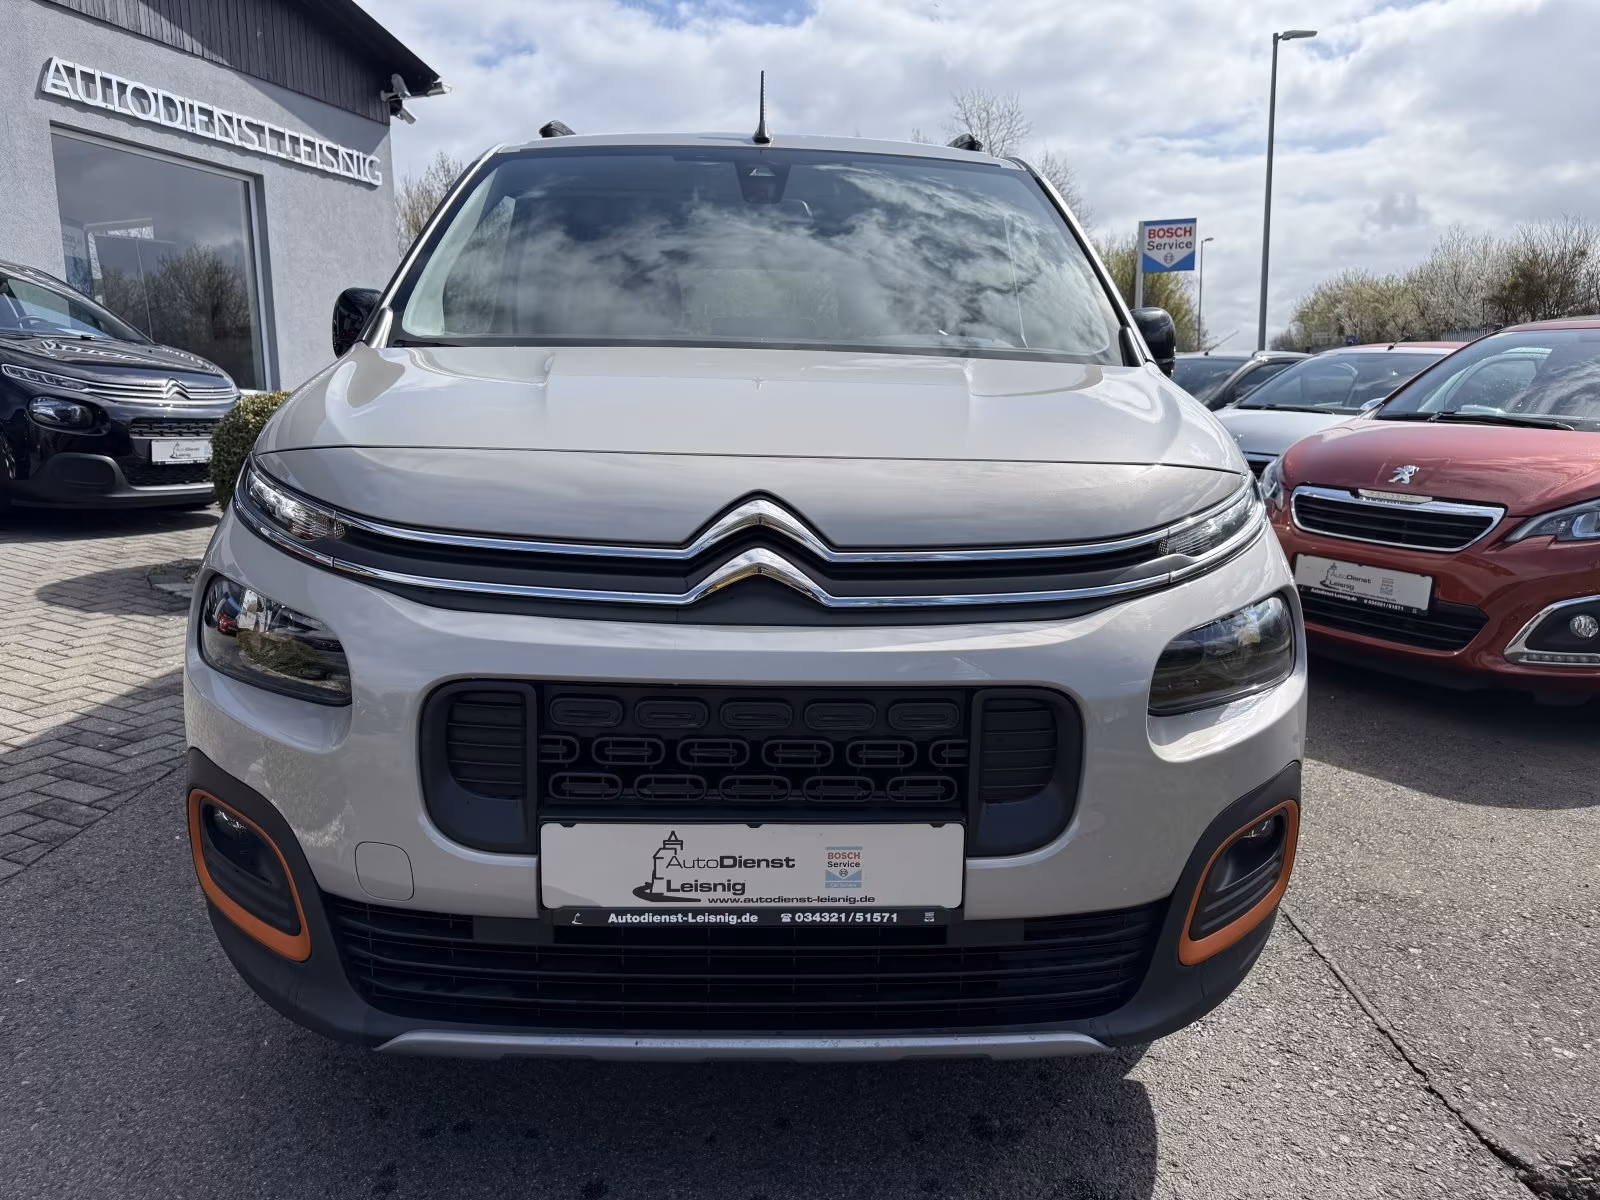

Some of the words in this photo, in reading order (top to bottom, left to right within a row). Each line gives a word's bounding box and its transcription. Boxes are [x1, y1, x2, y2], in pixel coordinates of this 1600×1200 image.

[1148, 226, 1192, 239] BOSCH
[1147, 239, 1193, 251] Service
[1329, 580, 1355, 591] Leisnig
[827, 851, 861, 860] BOSCH
[665, 855, 796, 869] AutoDienst
[827, 860, 861, 868] Service
[666, 879, 746, 896] Leisnig
[707, 895, 876, 905] www.autodienst-leisnig.de
[607, 912, 759, 925] Autodienst-Leisnig.de
[794, 912, 898, 923] 034321/51571
